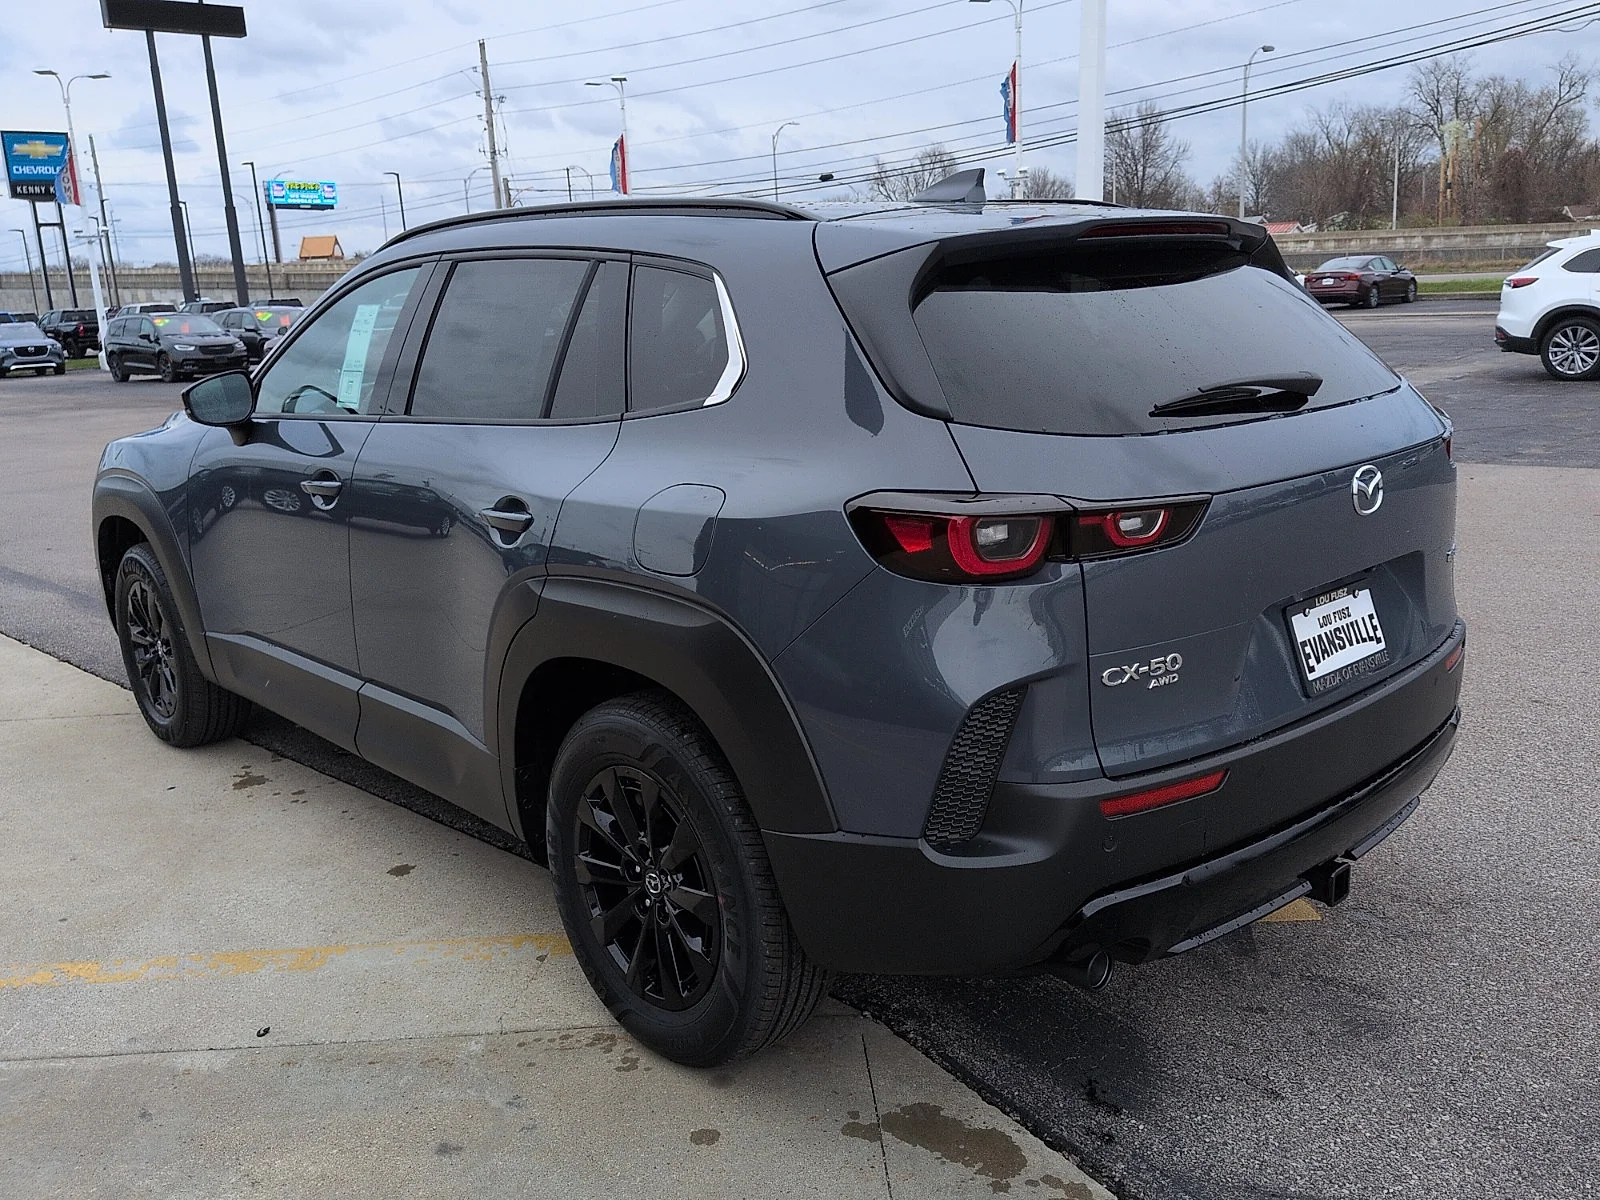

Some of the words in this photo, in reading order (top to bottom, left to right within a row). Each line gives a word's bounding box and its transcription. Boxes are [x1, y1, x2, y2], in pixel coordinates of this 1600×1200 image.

[13, 165, 62, 175] CHEVROLE
[16, 185, 46, 195] KENNY
[1315, 594, 1331, 607] LOU
[1331, 587, 1348, 601] FUSZ
[1317, 614, 1333, 629] LOU
[1333, 606, 1352, 624] FUSZ
[1299, 613, 1383, 675] EVANSVILLE
[1101, 653, 1183, 687] CX-50
[1312, 673, 1342, 694] MAZDA
[1342, 667, 1354, 680] OF
[1354, 650, 1390, 676] EVANSVILLE
[1147, 673, 1179, 690] AWD
